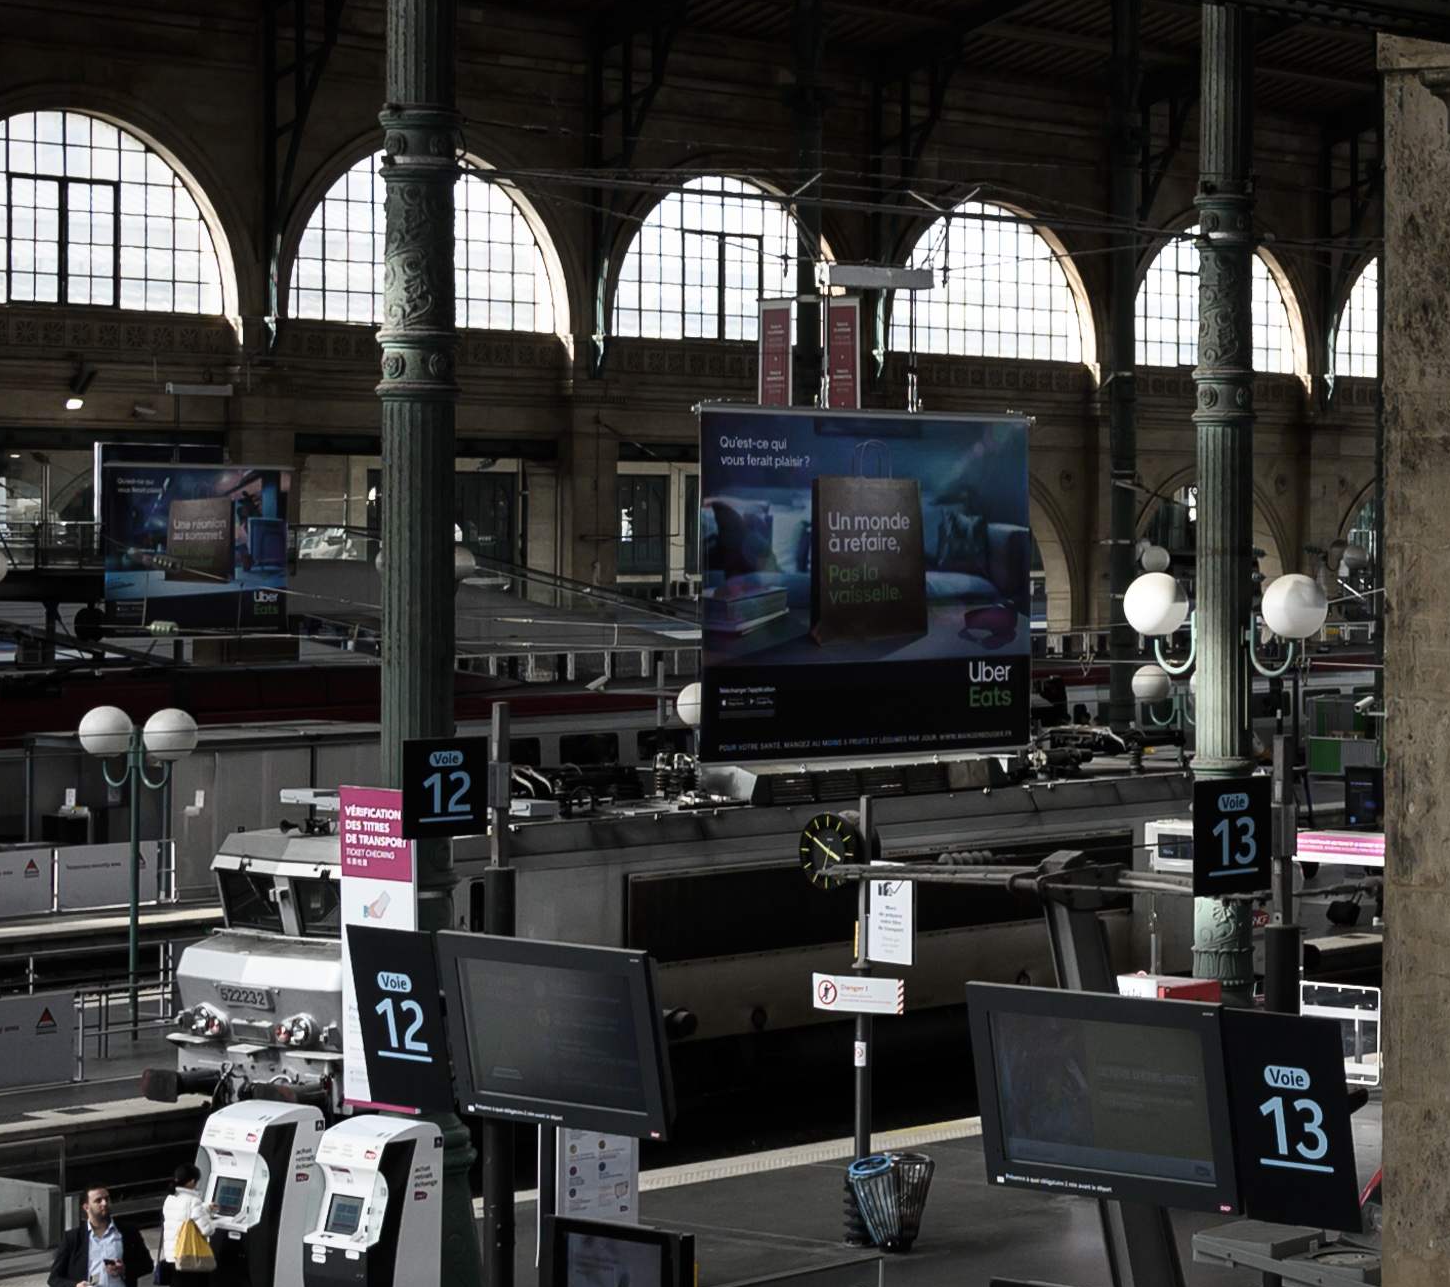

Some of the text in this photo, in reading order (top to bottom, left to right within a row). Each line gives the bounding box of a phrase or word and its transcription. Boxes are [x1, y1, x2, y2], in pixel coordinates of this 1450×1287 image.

[720, 435, 787, 452] Qu'est-ce qui
[720, 454, 802, 469] vous ferait plaisir
[828, 512, 910, 530] Un monde
[828, 533, 901, 554] à refaire,
[829, 563, 878, 583] Pas la
[254, 591, 278, 602] Uber
[829, 584, 903, 605] vaisselle.
[969, 661, 1012, 683] Uber
[969, 686, 1012, 708] Eats
[434, 753, 459, 764] Voie
[423, 771, 471, 814] 12
[1222, 795, 1245, 810] Voie
[345, 805, 401, 820] VÉRIFICATION
[346, 821, 390, 832] DES TITRES
[346, 834, 407, 848] DE TRANSPORT
[1212, 815, 1258, 866] 13
[347, 848, 395, 859] TICKET CHECKING
[381, 975, 408, 990] Voie
[220, 988, 265, 1006] 522232
[375, 997, 429, 1052] 12
[1270, 1068, 1304, 1087] Voie
[1259, 1096, 1328, 1160] 13
[415, 1165, 431, 1173] achat
[414, 1179, 437, 1188] échange
